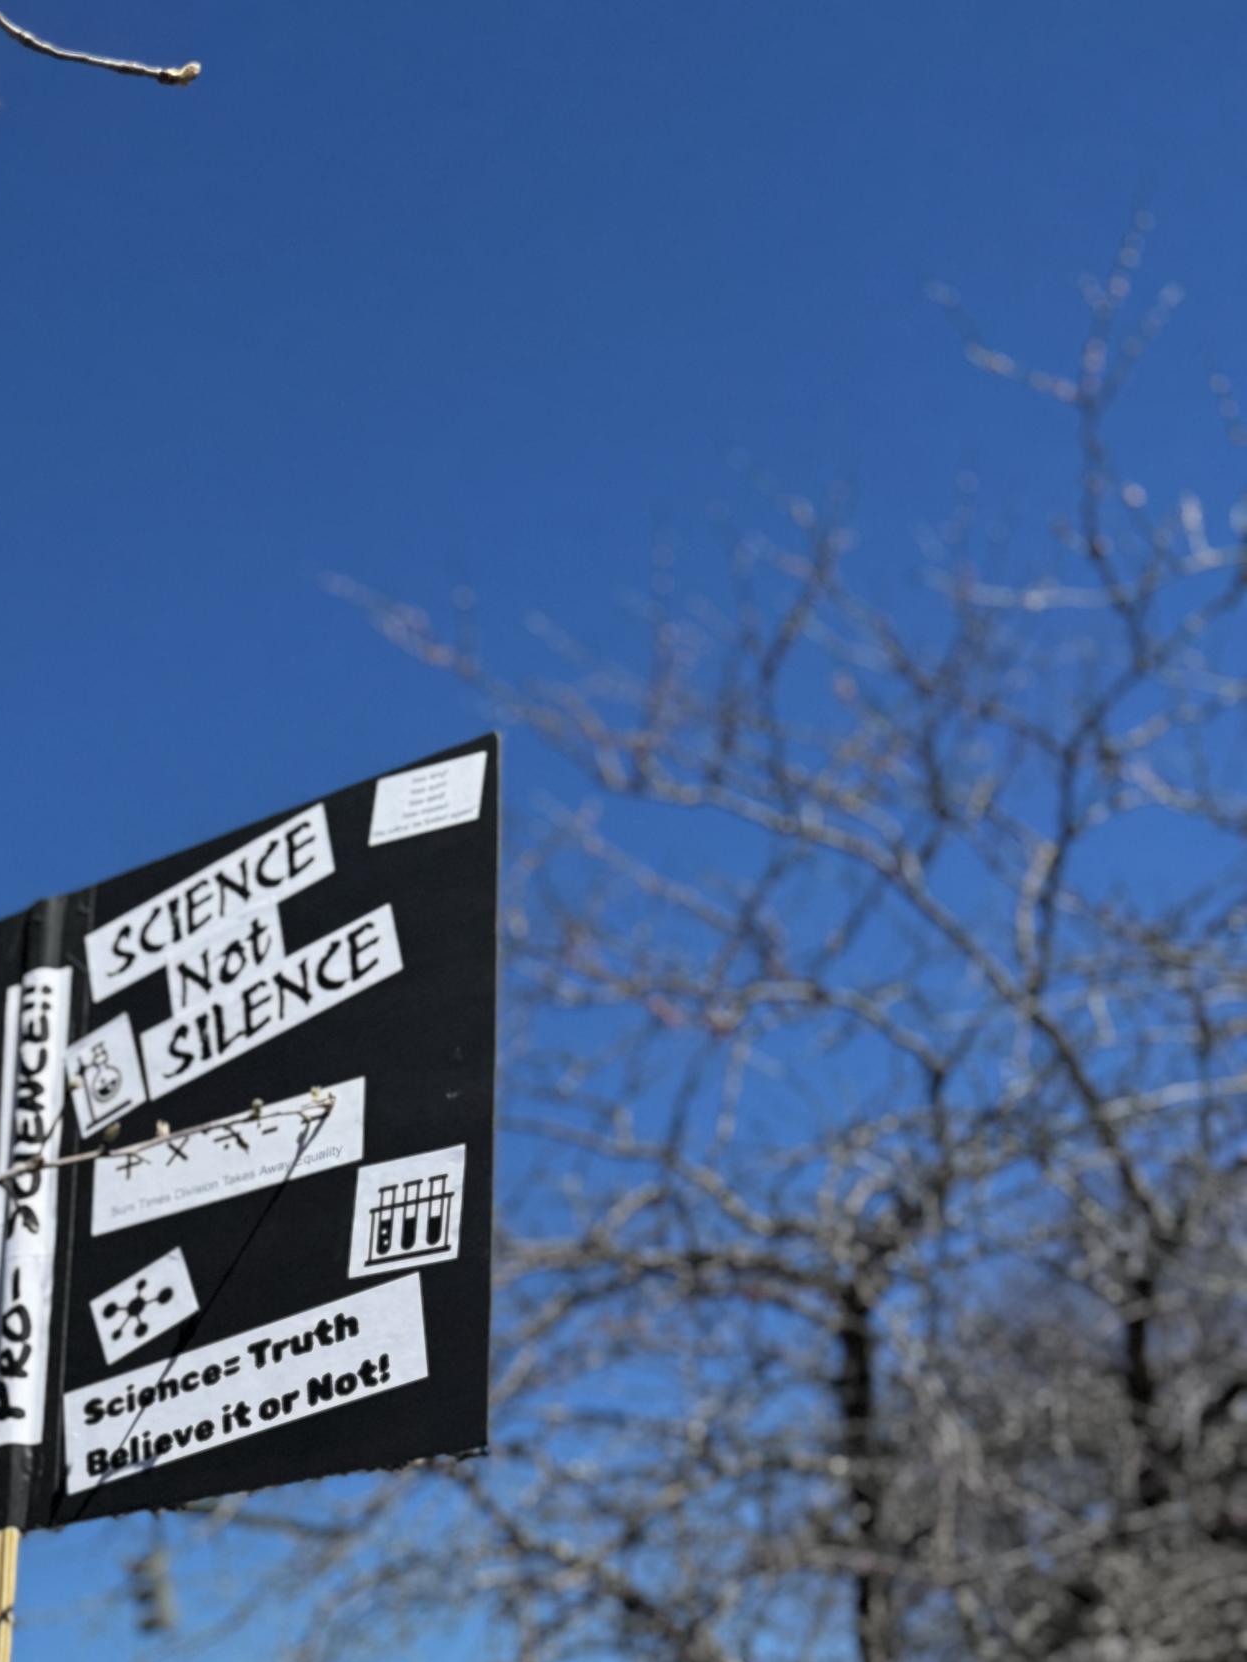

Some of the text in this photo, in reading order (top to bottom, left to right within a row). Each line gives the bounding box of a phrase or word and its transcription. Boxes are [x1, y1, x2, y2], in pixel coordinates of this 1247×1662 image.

[106, 821, 316, 978] SCIENCE
[162, 921, 381, 1079] SILENCE
[176, 917, 272, 1008] Not
[222, 1170, 255, 1187] Takes
[259, 1160, 290, 1176] Away
[83, 1312, 360, 1426] Science= Truth
[86, 1353, 390, 1478] Believe it or Not!
